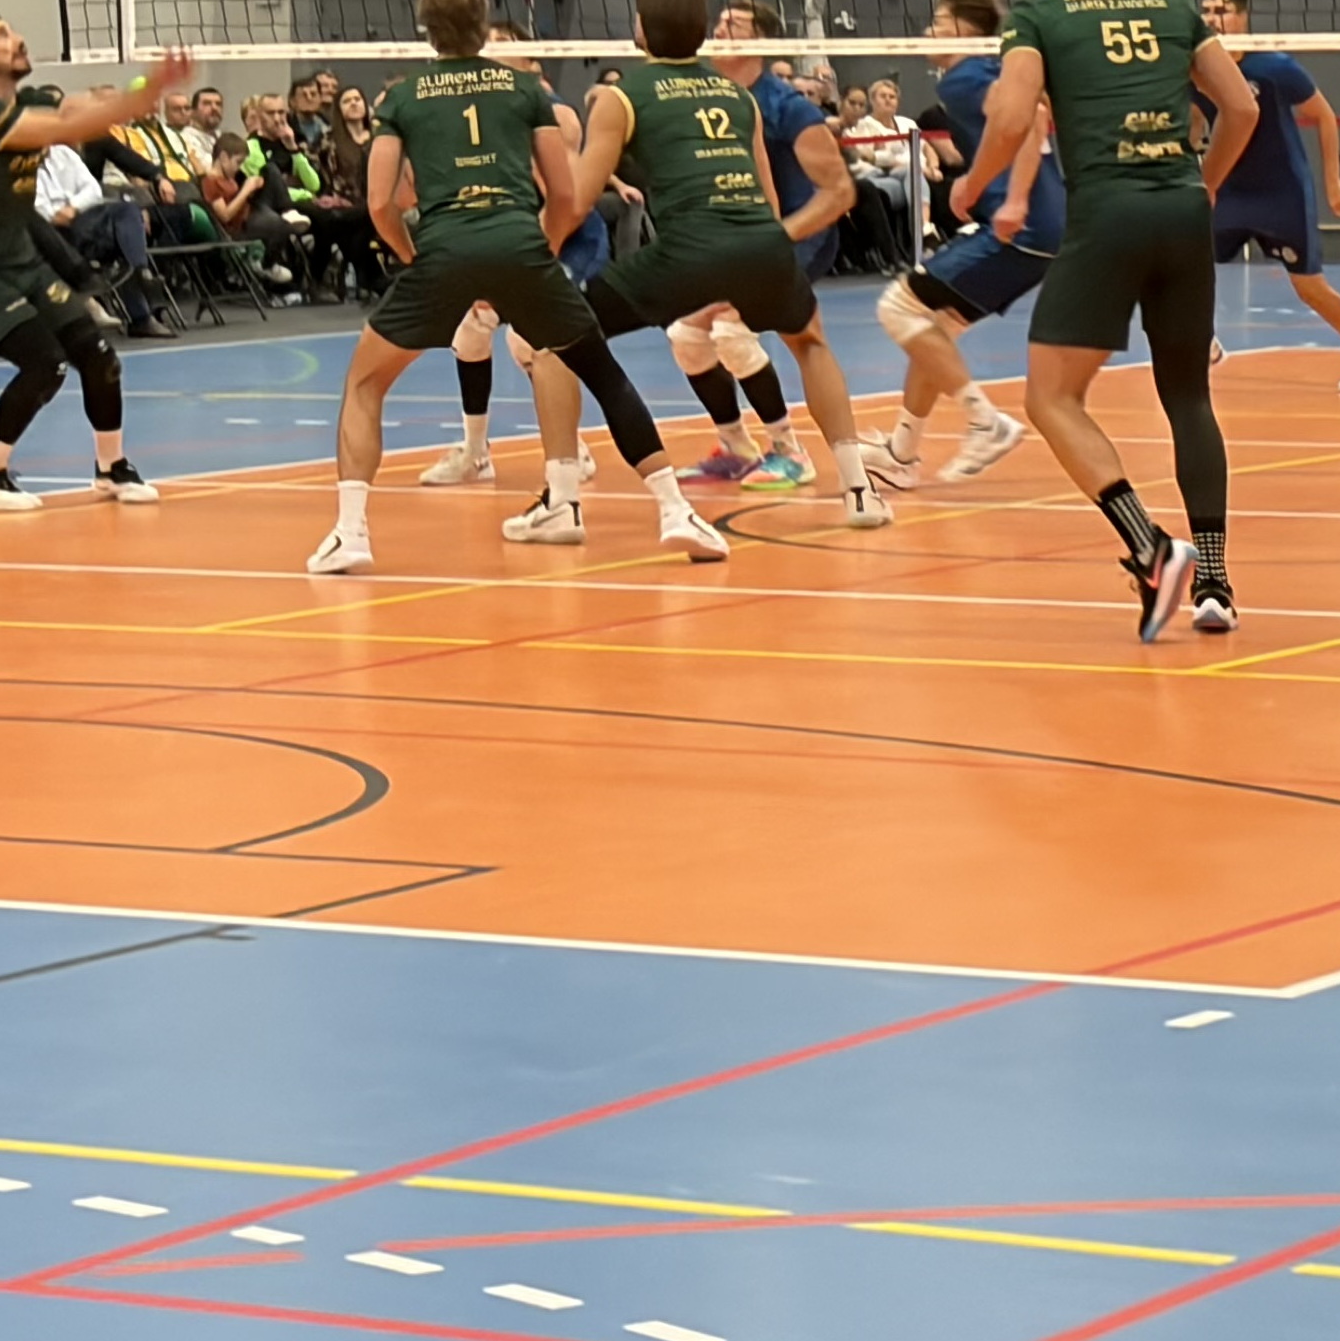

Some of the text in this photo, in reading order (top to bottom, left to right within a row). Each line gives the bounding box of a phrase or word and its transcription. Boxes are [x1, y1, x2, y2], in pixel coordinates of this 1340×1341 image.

[1100, 18, 1161, 64] 55
[416, 68, 515, 90] ALURON CMC
[462, 103, 481, 146] 1
[693, 106, 738, 140] 12
